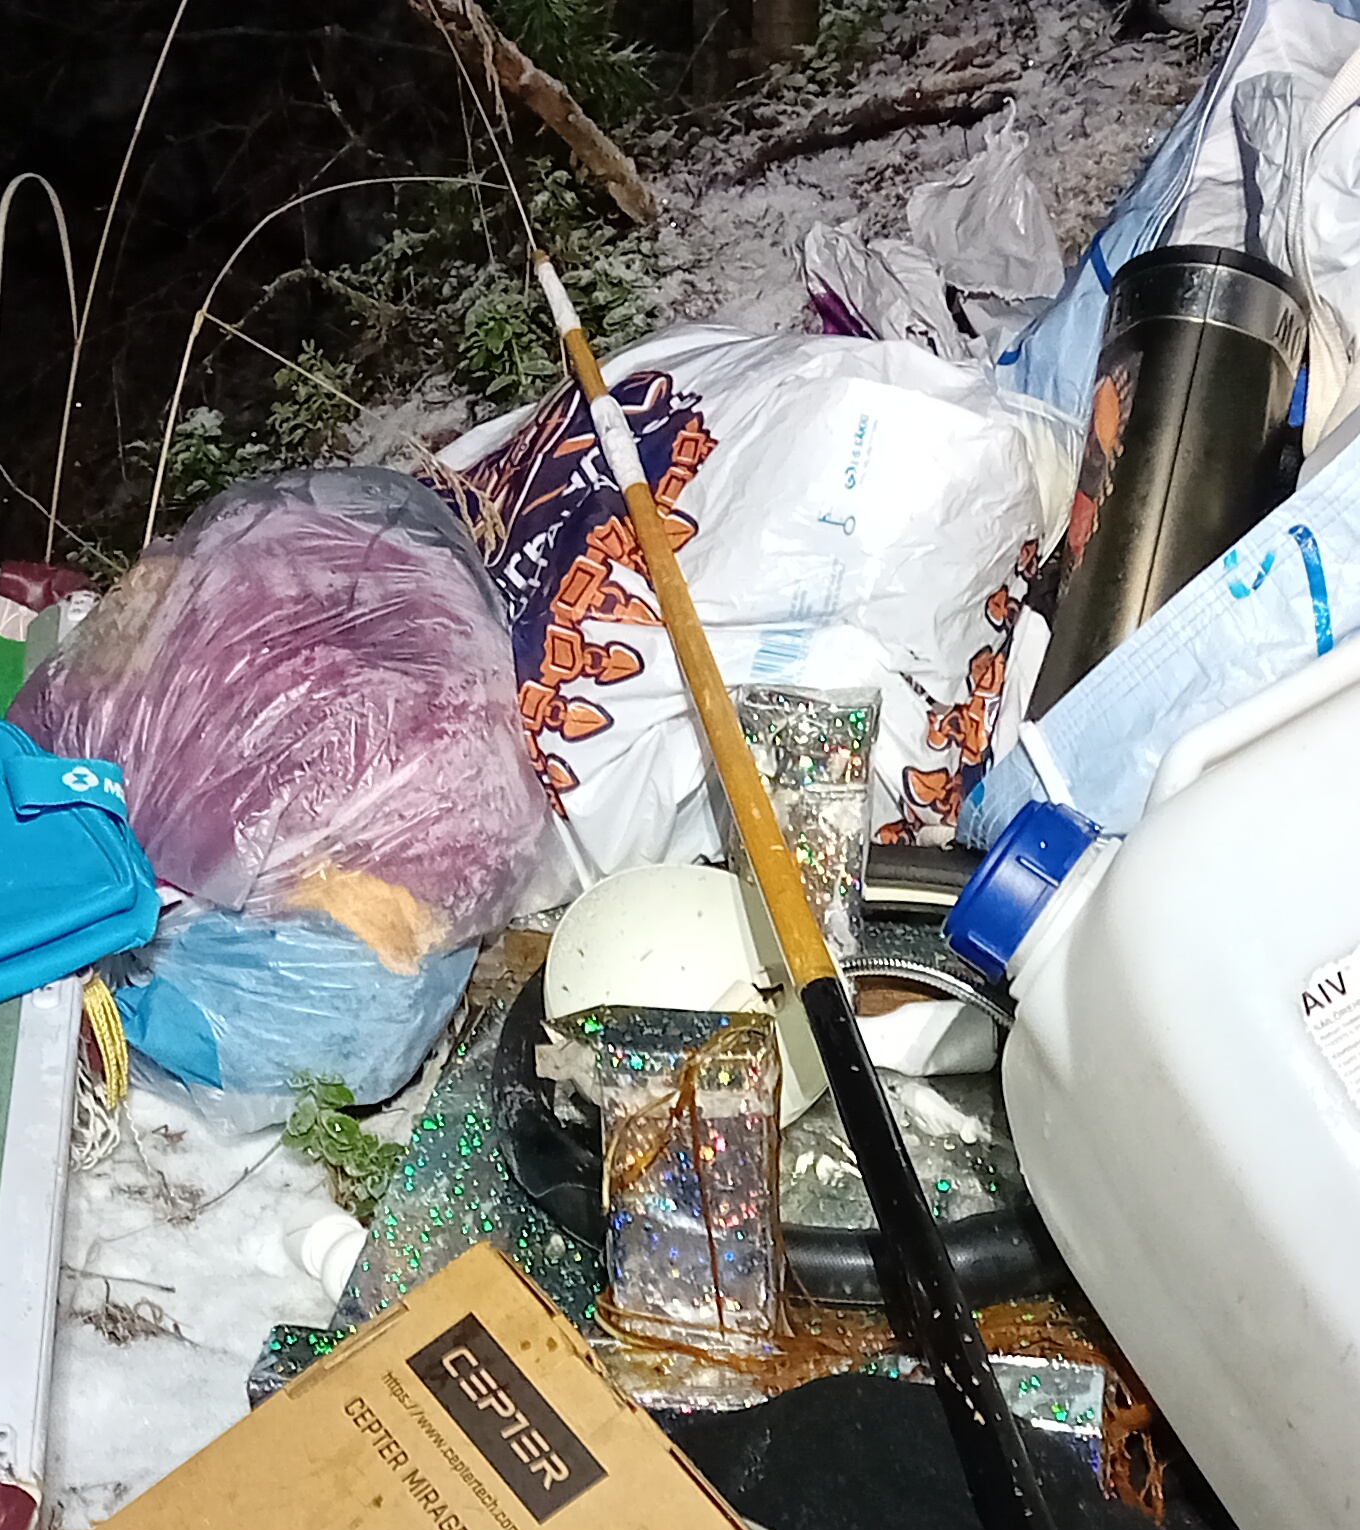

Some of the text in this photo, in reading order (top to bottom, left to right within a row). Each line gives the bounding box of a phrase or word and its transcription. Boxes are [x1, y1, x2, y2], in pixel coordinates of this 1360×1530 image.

[1302, 972, 1346, 1016] AIV
[343, 1396, 409, 1472] CEPTER
[441, 1346, 572, 1491] CEPTER
